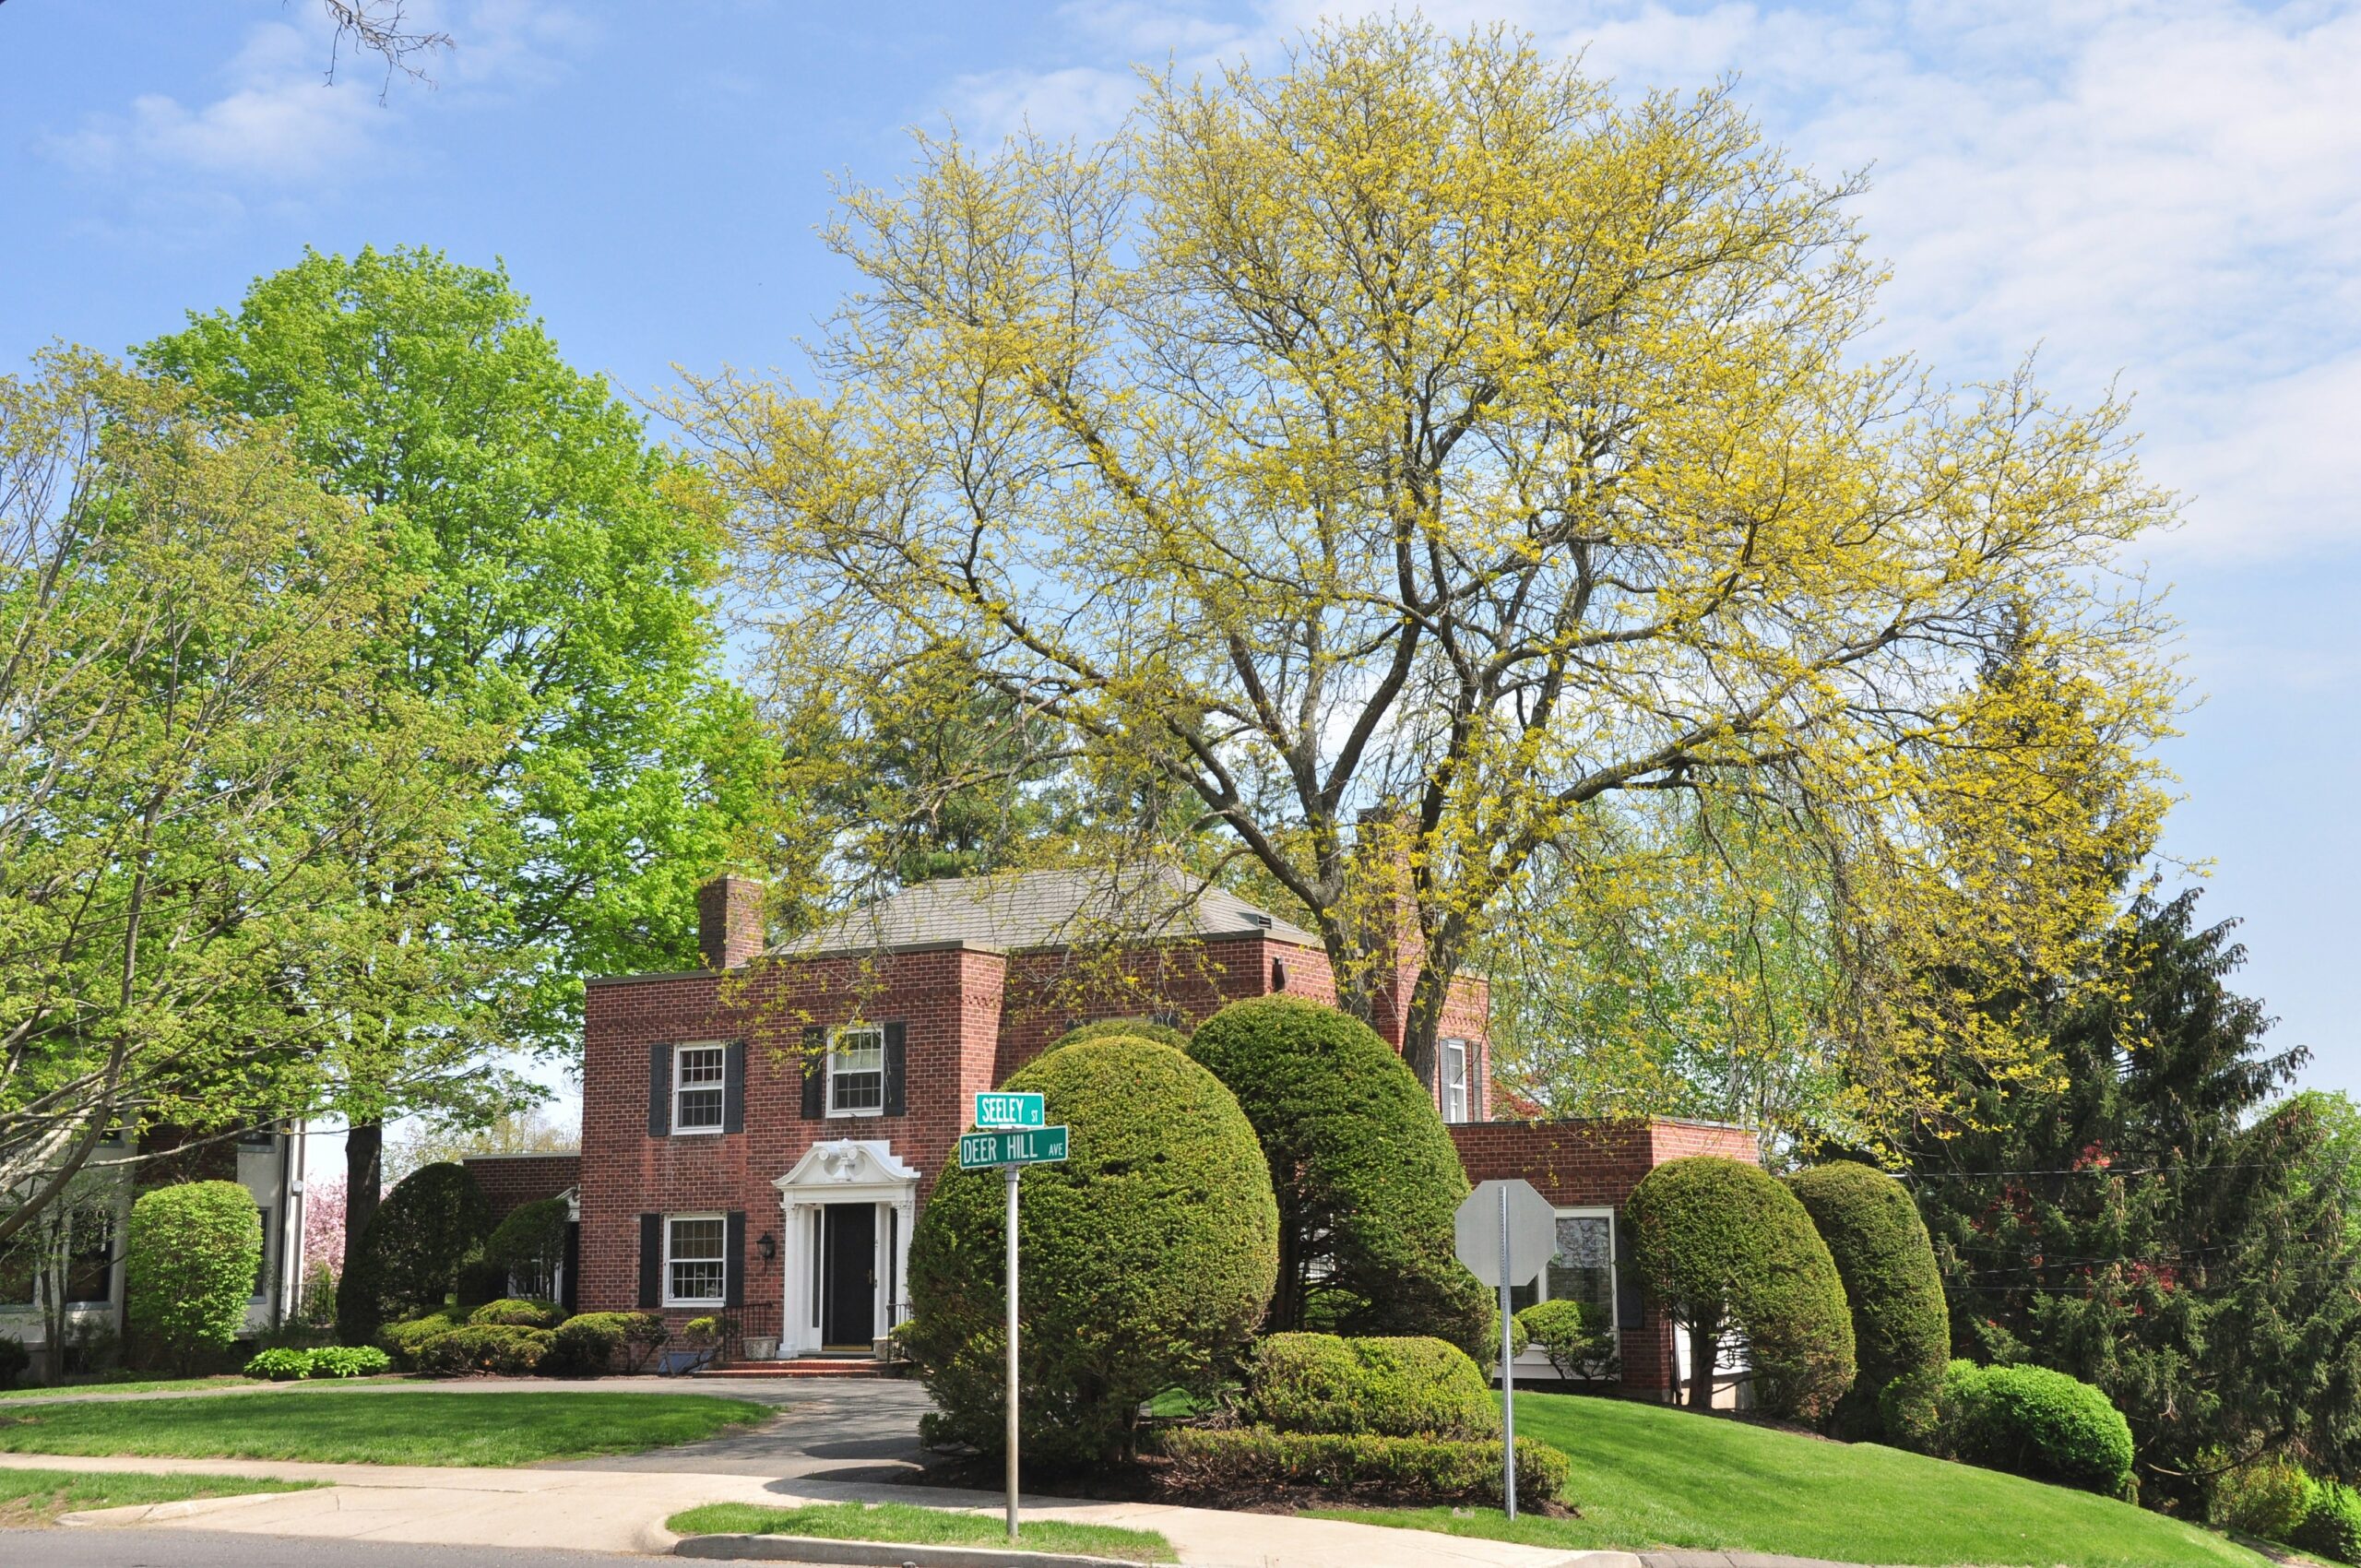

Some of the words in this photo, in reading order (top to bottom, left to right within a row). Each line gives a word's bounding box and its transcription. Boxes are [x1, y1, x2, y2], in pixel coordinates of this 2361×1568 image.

[981, 1098, 1024, 1123] SEELEY
[1031, 1110, 1038, 1123] ST
[963, 1137, 997, 1164] DEER
[1006, 1134, 1038, 1160] HILL
[1048, 1143, 1063, 1157] AVE
